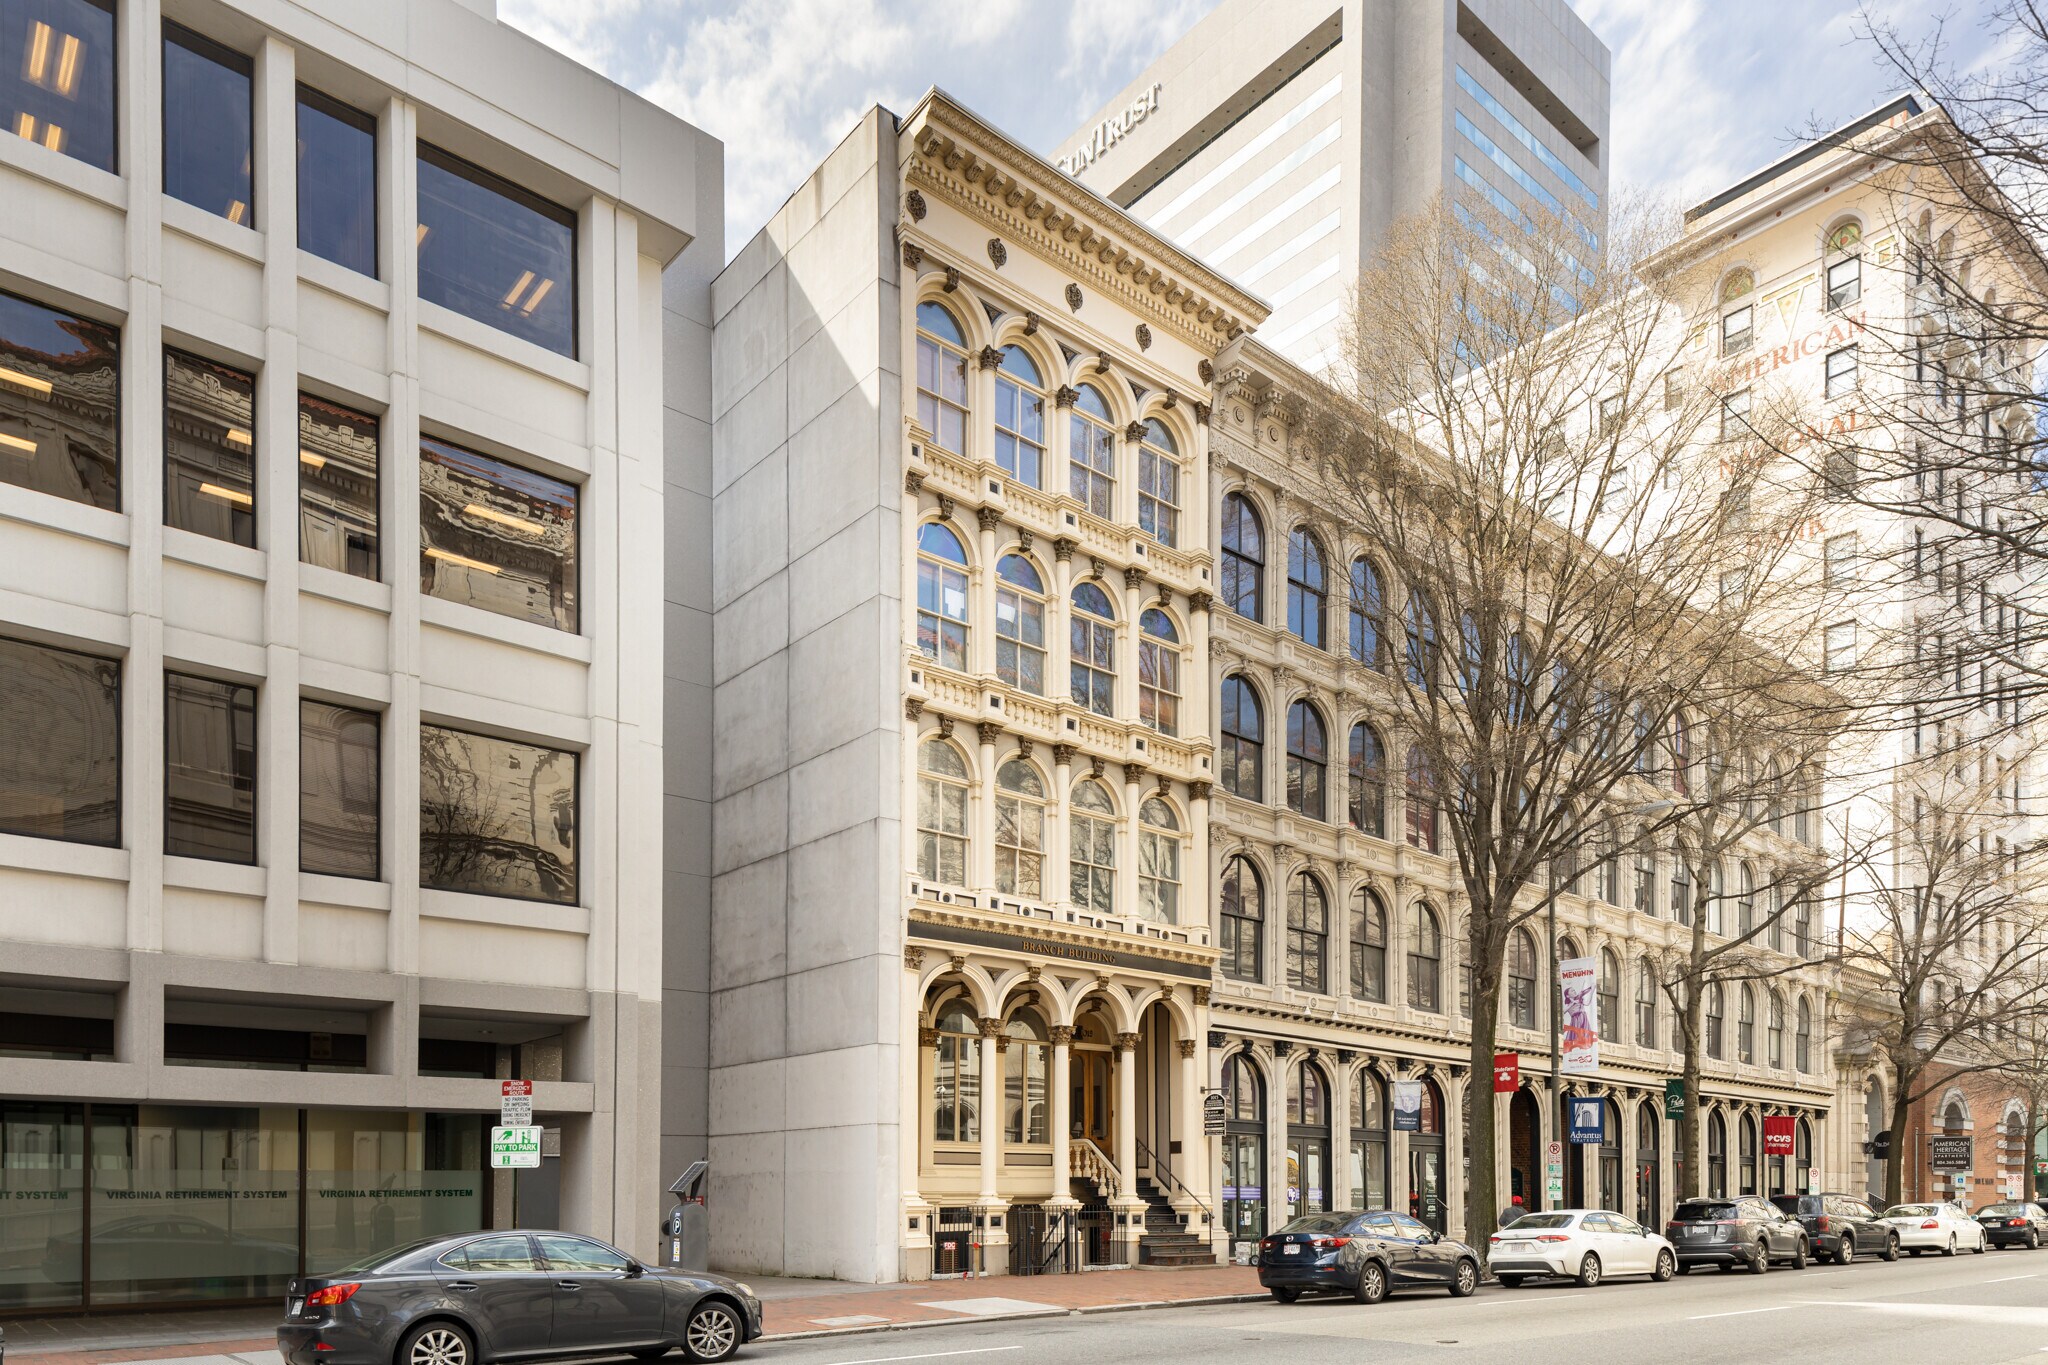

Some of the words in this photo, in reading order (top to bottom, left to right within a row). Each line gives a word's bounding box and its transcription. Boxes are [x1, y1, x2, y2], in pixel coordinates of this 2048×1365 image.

[1712, 310, 1868, 395] AMERICAN
[1023, 940, 1064, 956] BRANCH
[1069, 948, 1116, 964] BUILDING
[1561, 969, 1594, 979] MENUHIN
[1570, 1131, 1602, 1139] Advantus
[1773, 1135, 1792, 1143] CVS
[518, 1143, 537, 1151] PARK
[0, 1191, 15, 1200] T
[16, 1191, 68, 1200] SYSTEM
[106, 1191, 161, 1199] VIRGINIA
[165, 1190, 239, 1199] RETIREMENT
[243, 1190, 288, 1199] SYSTEM
[319, 1190, 366, 1198] VIRGINIA
[369, 1189, 432, 1198] RETIREMENT
[435, 1189, 473, 1197] SYSTEM
